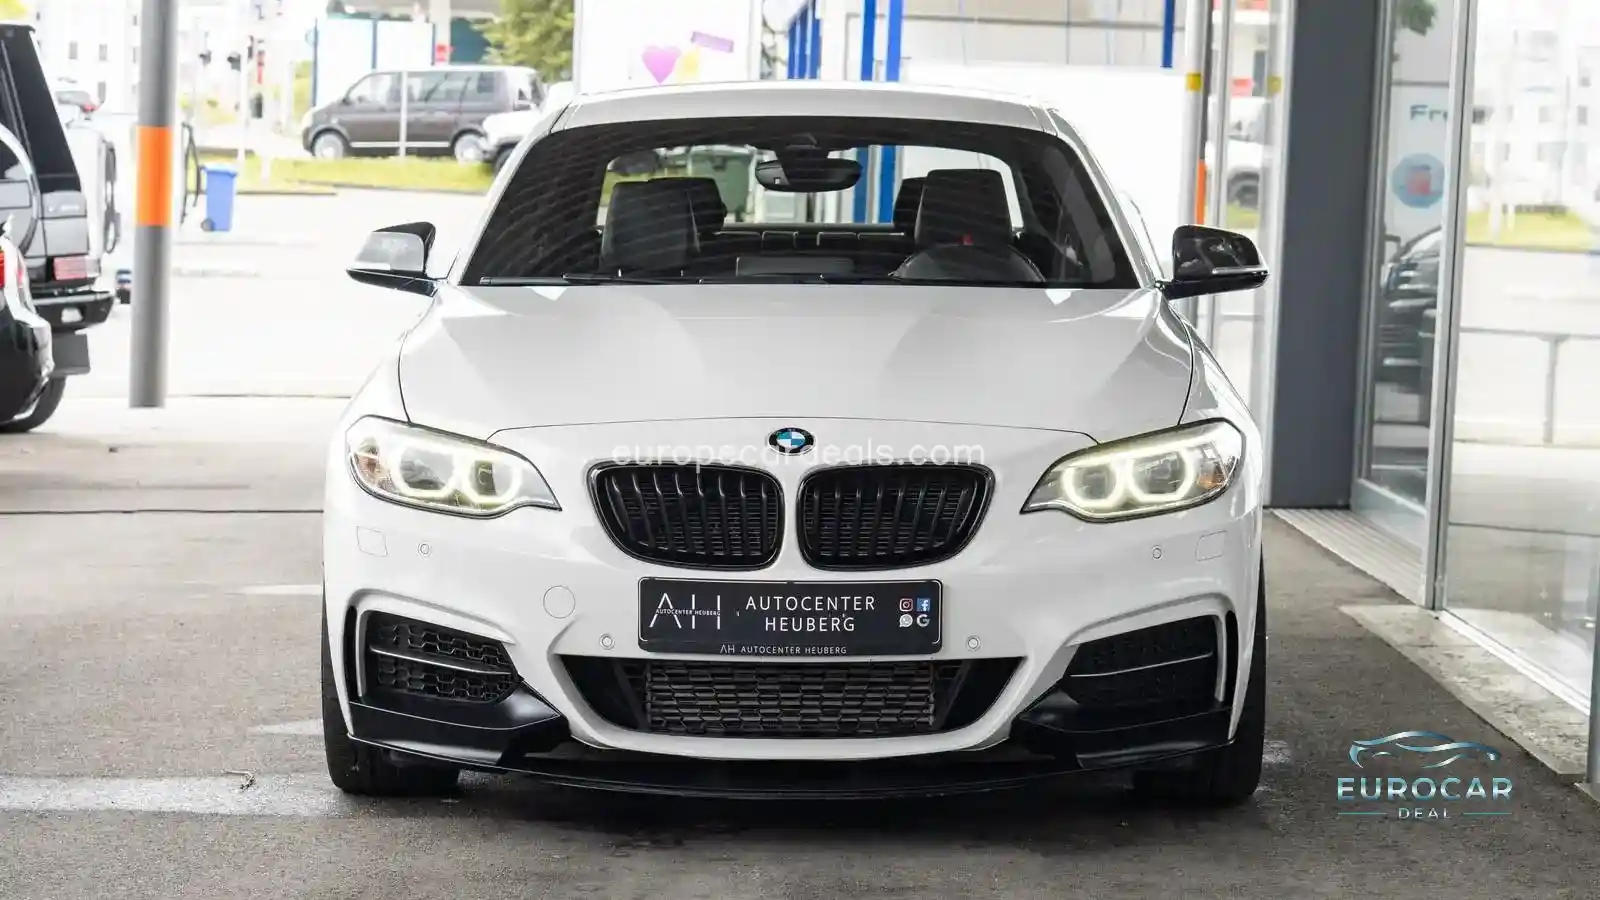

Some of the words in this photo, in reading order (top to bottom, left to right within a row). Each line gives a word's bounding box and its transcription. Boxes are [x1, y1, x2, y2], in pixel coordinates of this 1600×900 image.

[649, 592, 721, 630] AH
[745, 596, 876, 611] AUTOCENTER
[655, 608, 693, 616] AUTOCENTER
[765, 616, 856, 632] HEUBERG
[719, 643, 736, 654] AH
[740, 645, 801, 654] AUTOCENTER
[804, 646, 847, 655] HEUBERG
